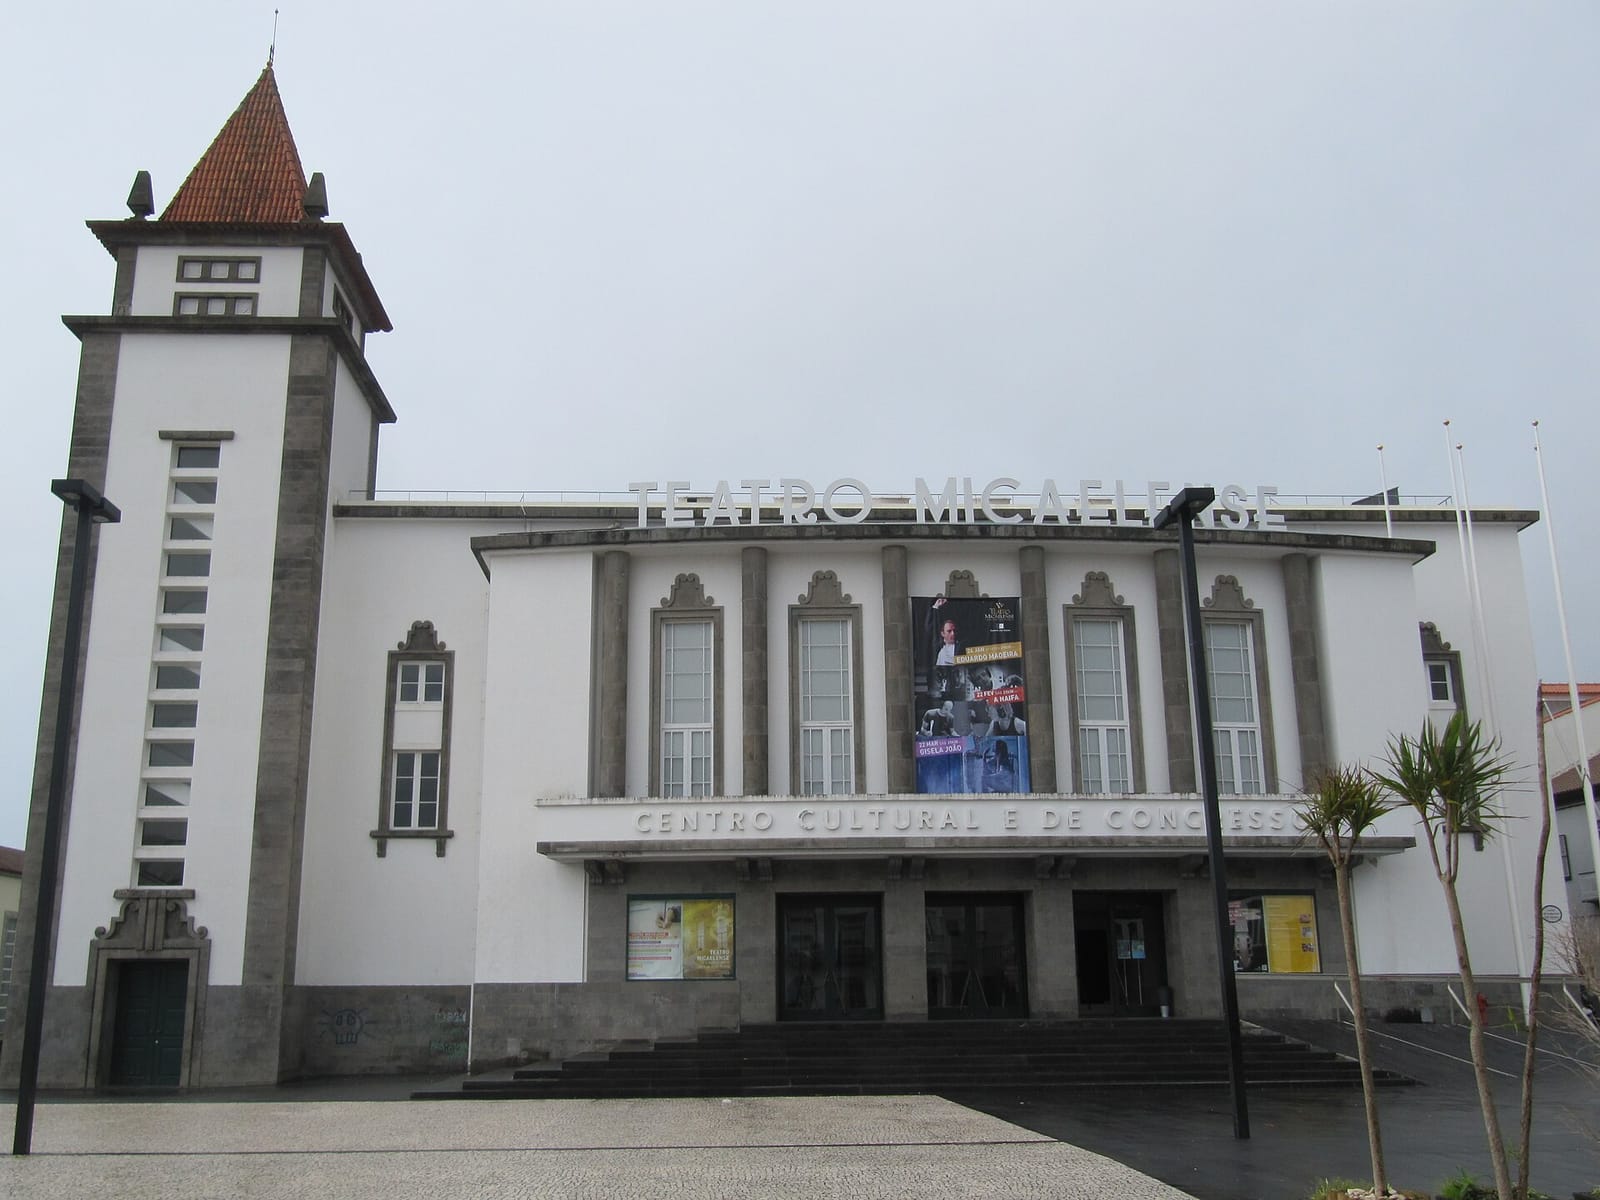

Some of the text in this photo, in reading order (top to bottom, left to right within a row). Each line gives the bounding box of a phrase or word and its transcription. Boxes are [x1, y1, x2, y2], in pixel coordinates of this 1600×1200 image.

[628, 477, 872, 527] TEATRO
[956, 651, 1018, 664] EDUARDO MADEIRA
[919, 746, 944, 756] GISELA
[636, 808, 774, 833] CENTRO
[799, 806, 981, 831] CULTURAL
[1004, 808, 1018, 831] E
[1042, 807, 1082, 831] DE
